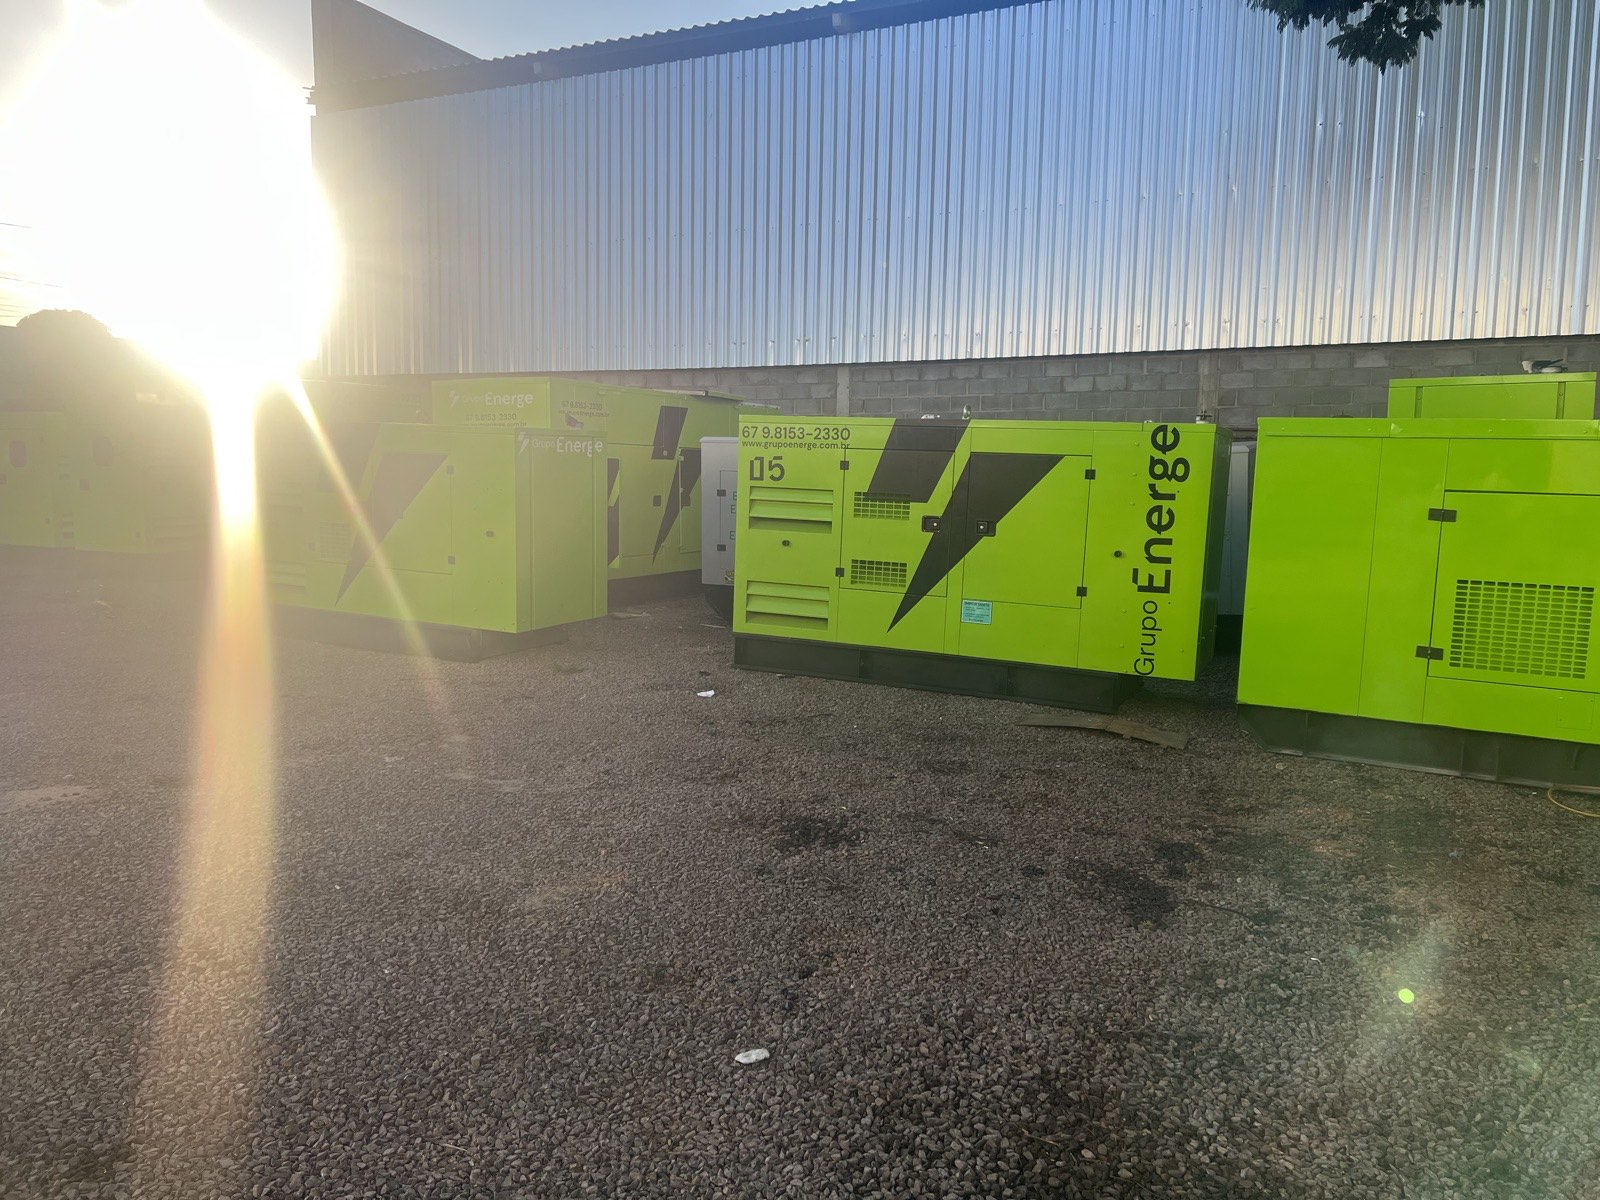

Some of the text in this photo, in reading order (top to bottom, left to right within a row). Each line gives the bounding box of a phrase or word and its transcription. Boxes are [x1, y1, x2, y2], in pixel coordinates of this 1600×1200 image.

[485, 392, 534, 408] Energe
[742, 426, 851, 440] 67 9.8153-2330
[556, 436, 603, 457] Energe
[741, 440, 851, 451] www.grupoenerge.com.br
[1132, 424, 1191, 676] Grupo Energe
